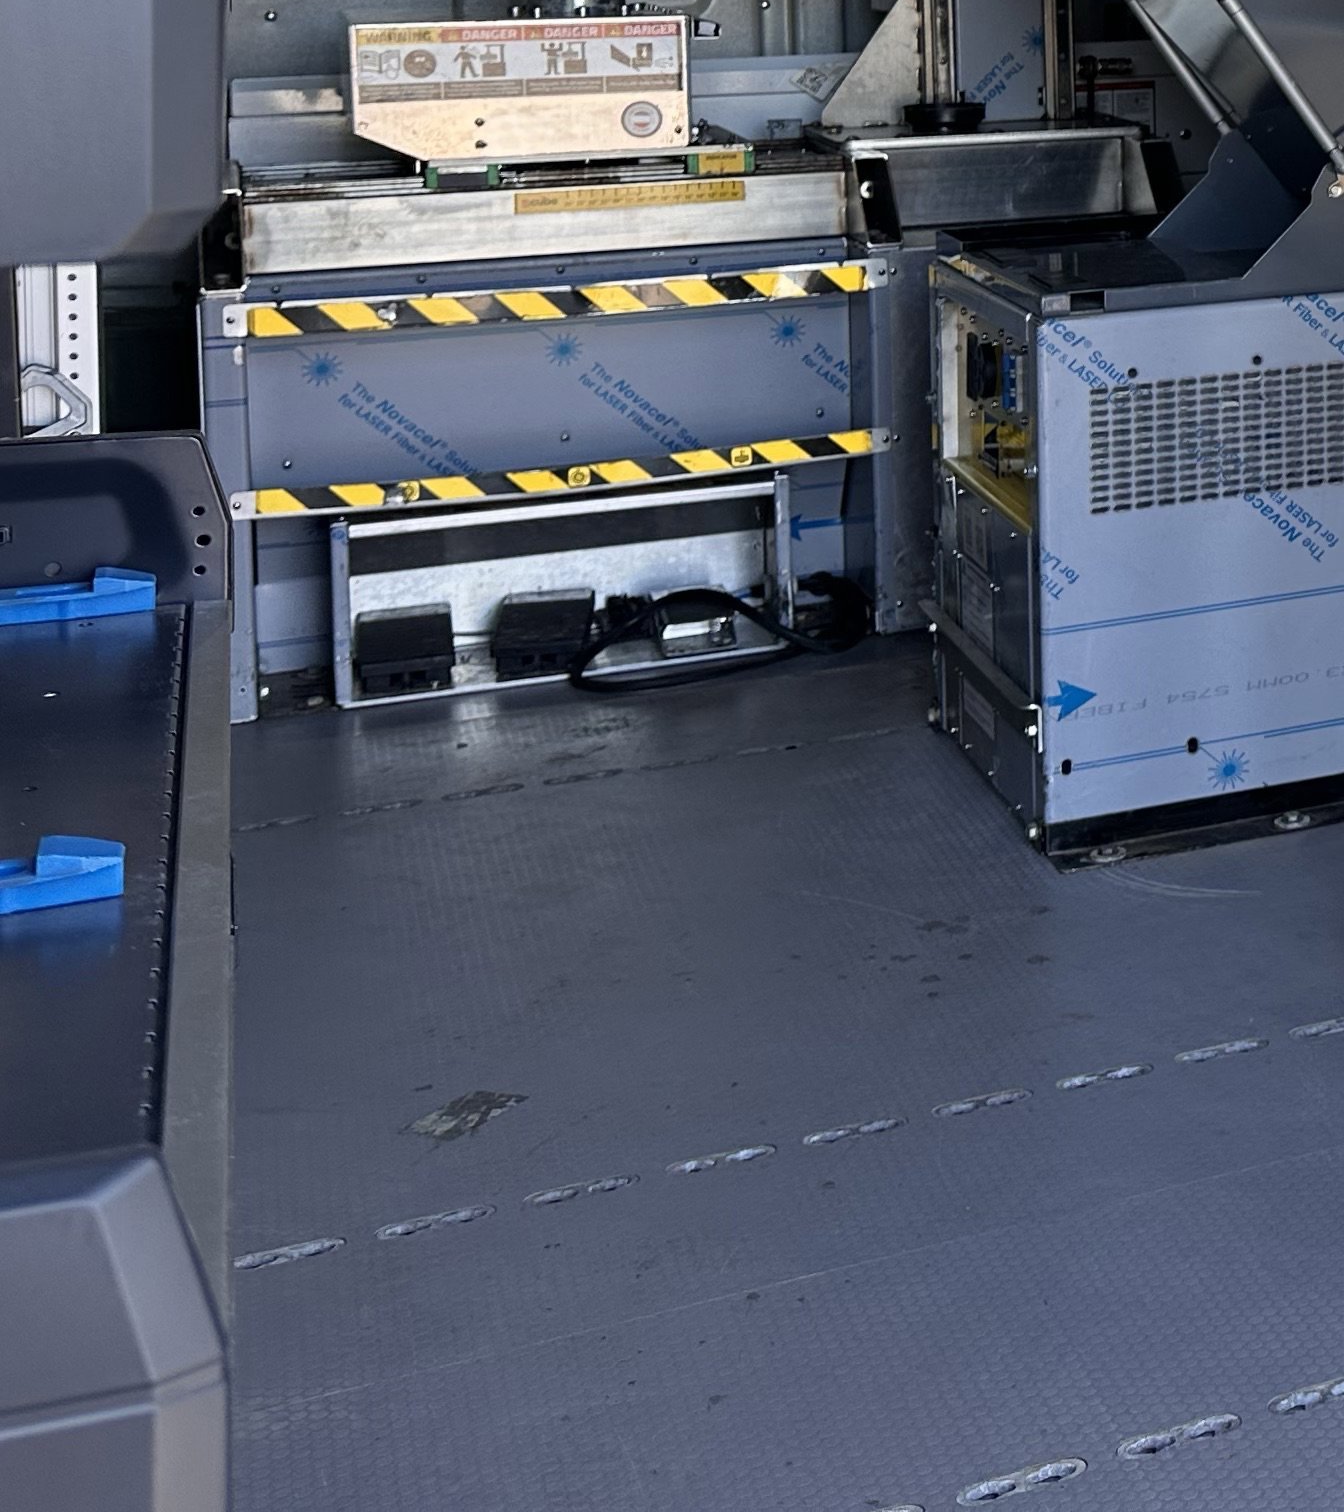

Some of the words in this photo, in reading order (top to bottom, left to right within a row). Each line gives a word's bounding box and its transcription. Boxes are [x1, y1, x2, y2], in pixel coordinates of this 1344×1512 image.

[462, 28, 518, 41] DANGER
[544, 26, 599, 38] DANGER
[624, 23, 677, 36] DANGER
[1292, 302, 1324, 331] Fiber
[590, 361, 613, 384] The
[352, 380, 376, 404] The
[578, 373, 598, 388] for
[593, 385, 629, 416] LASER
[626, 408, 655, 434] Fiber
[338, 393, 357, 410] for
[355, 406, 393, 437] LASER
[391, 431, 420, 457] Fiber
[1285, 499, 1323, 535] LASER
[1302, 537, 1326, 564] The
[1320, 529, 1340, 549] for
[1058, 565, 1081, 585] for
[1167, 684, 1231, 705] 5754
